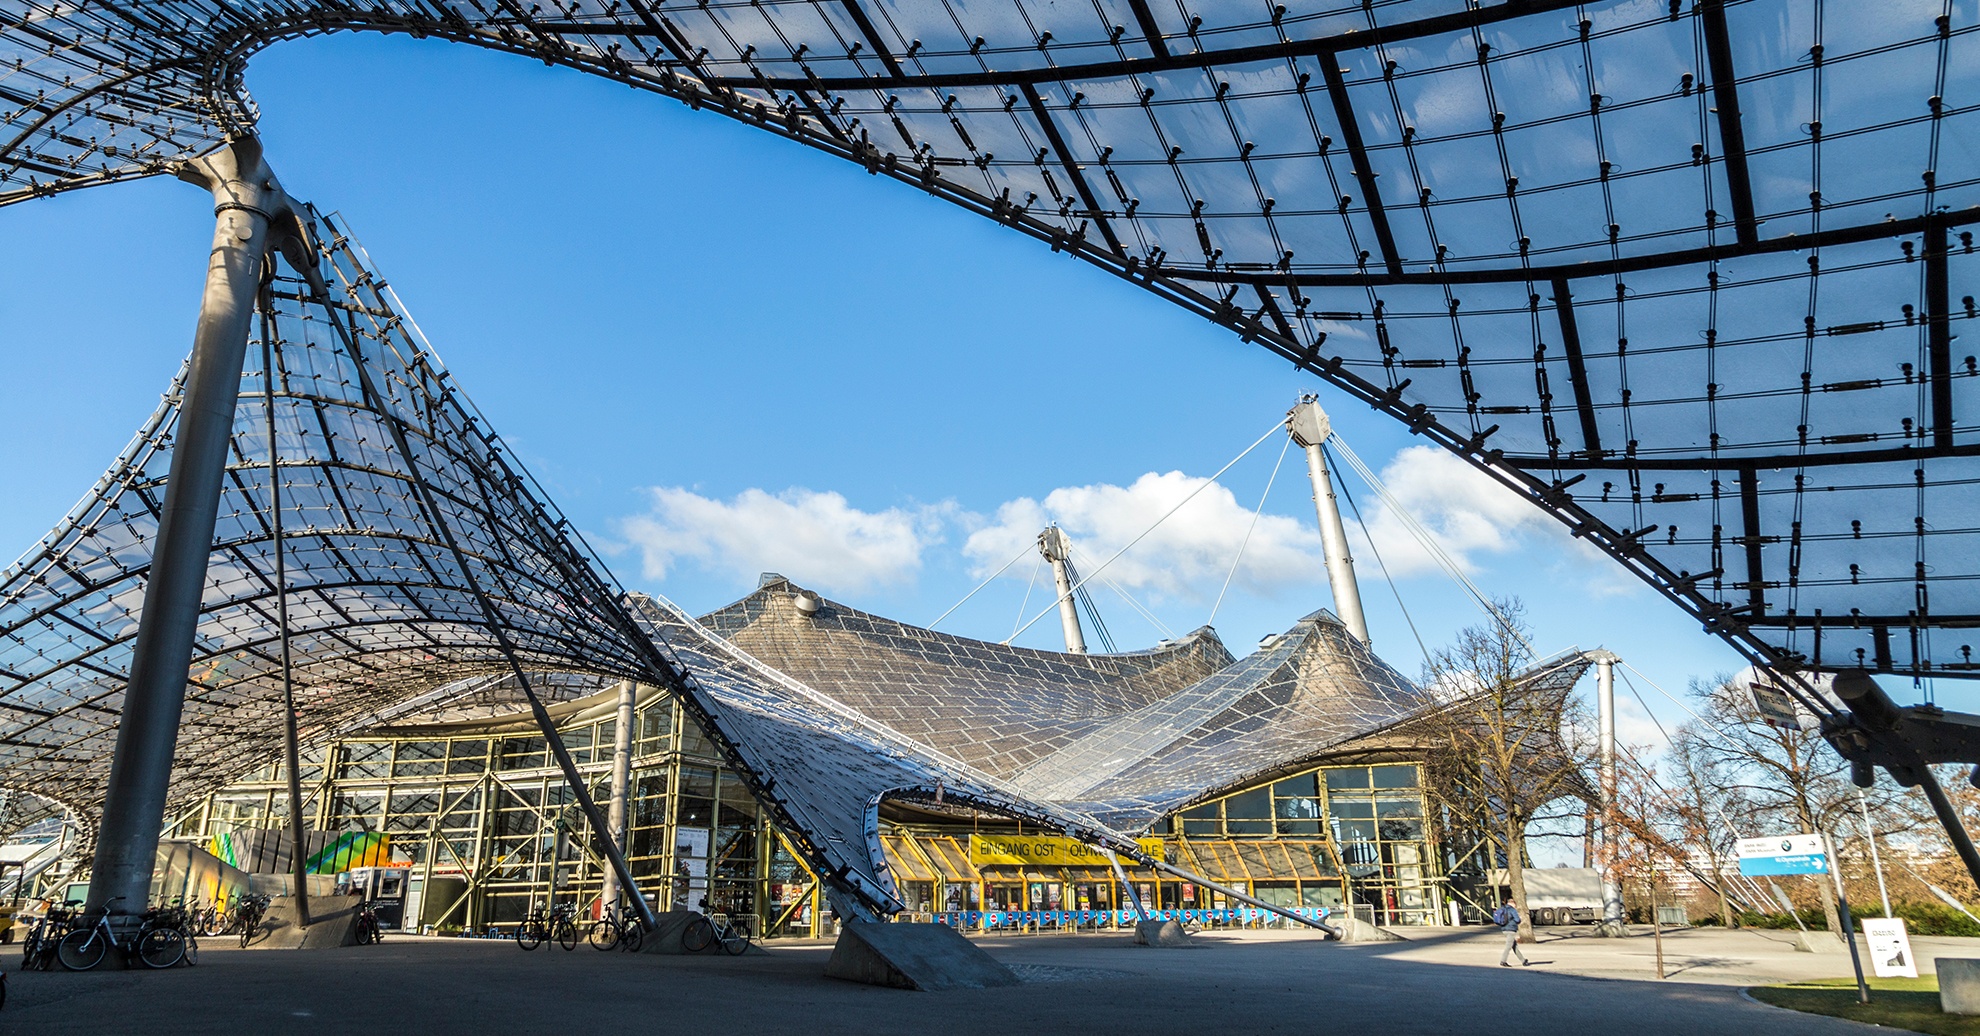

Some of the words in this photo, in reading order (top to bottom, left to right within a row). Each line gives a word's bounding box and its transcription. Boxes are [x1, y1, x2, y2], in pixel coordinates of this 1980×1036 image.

[980, 843, 1029, 856] EINGANG
[1035, 844, 1056, 857] OST
[1069, 844, 1158, 857] OLYMLLE
